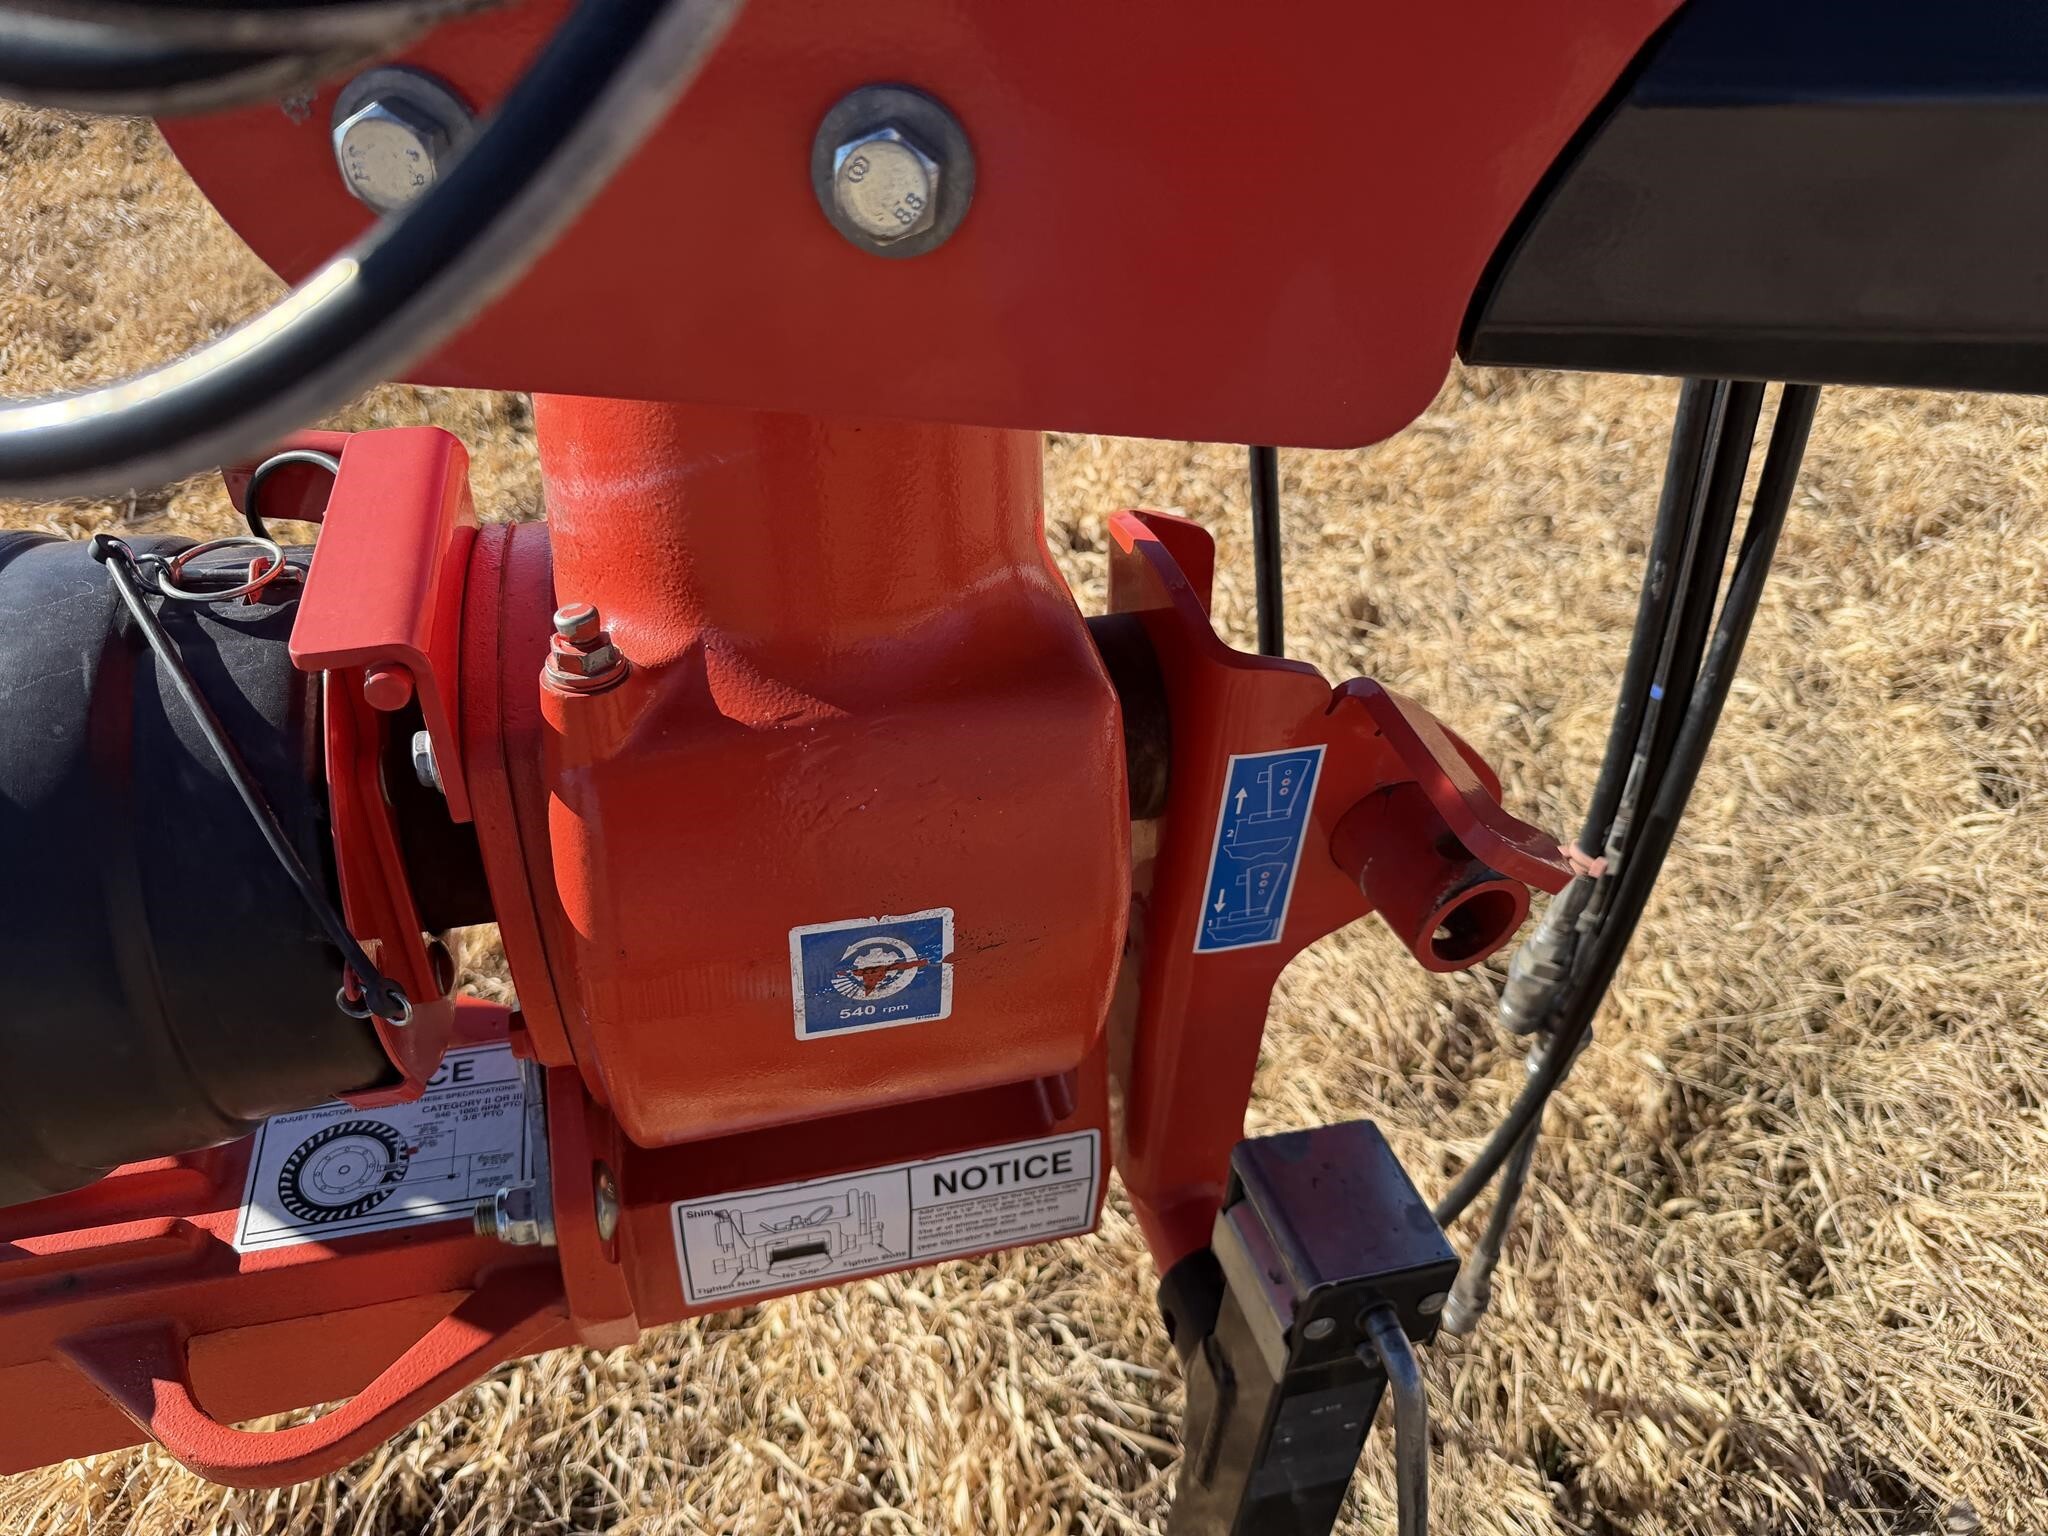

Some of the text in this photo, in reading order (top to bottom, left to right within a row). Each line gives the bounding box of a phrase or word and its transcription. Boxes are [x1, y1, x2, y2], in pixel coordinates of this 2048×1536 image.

[1226, 829, 1235, 838] 2
[839, 1004, 909, 1019] 540 rpm
[422, 1099, 482, 1113] CATEGORY
[494, 1094, 510, 1102] OR
[274, 1108, 352, 1125] ADJUST TRACTOR
[483, 1109, 504, 1118] PTO
[933, 1150, 1073, 1197] NOTICE
[686, 1209, 714, 1219] Shim
